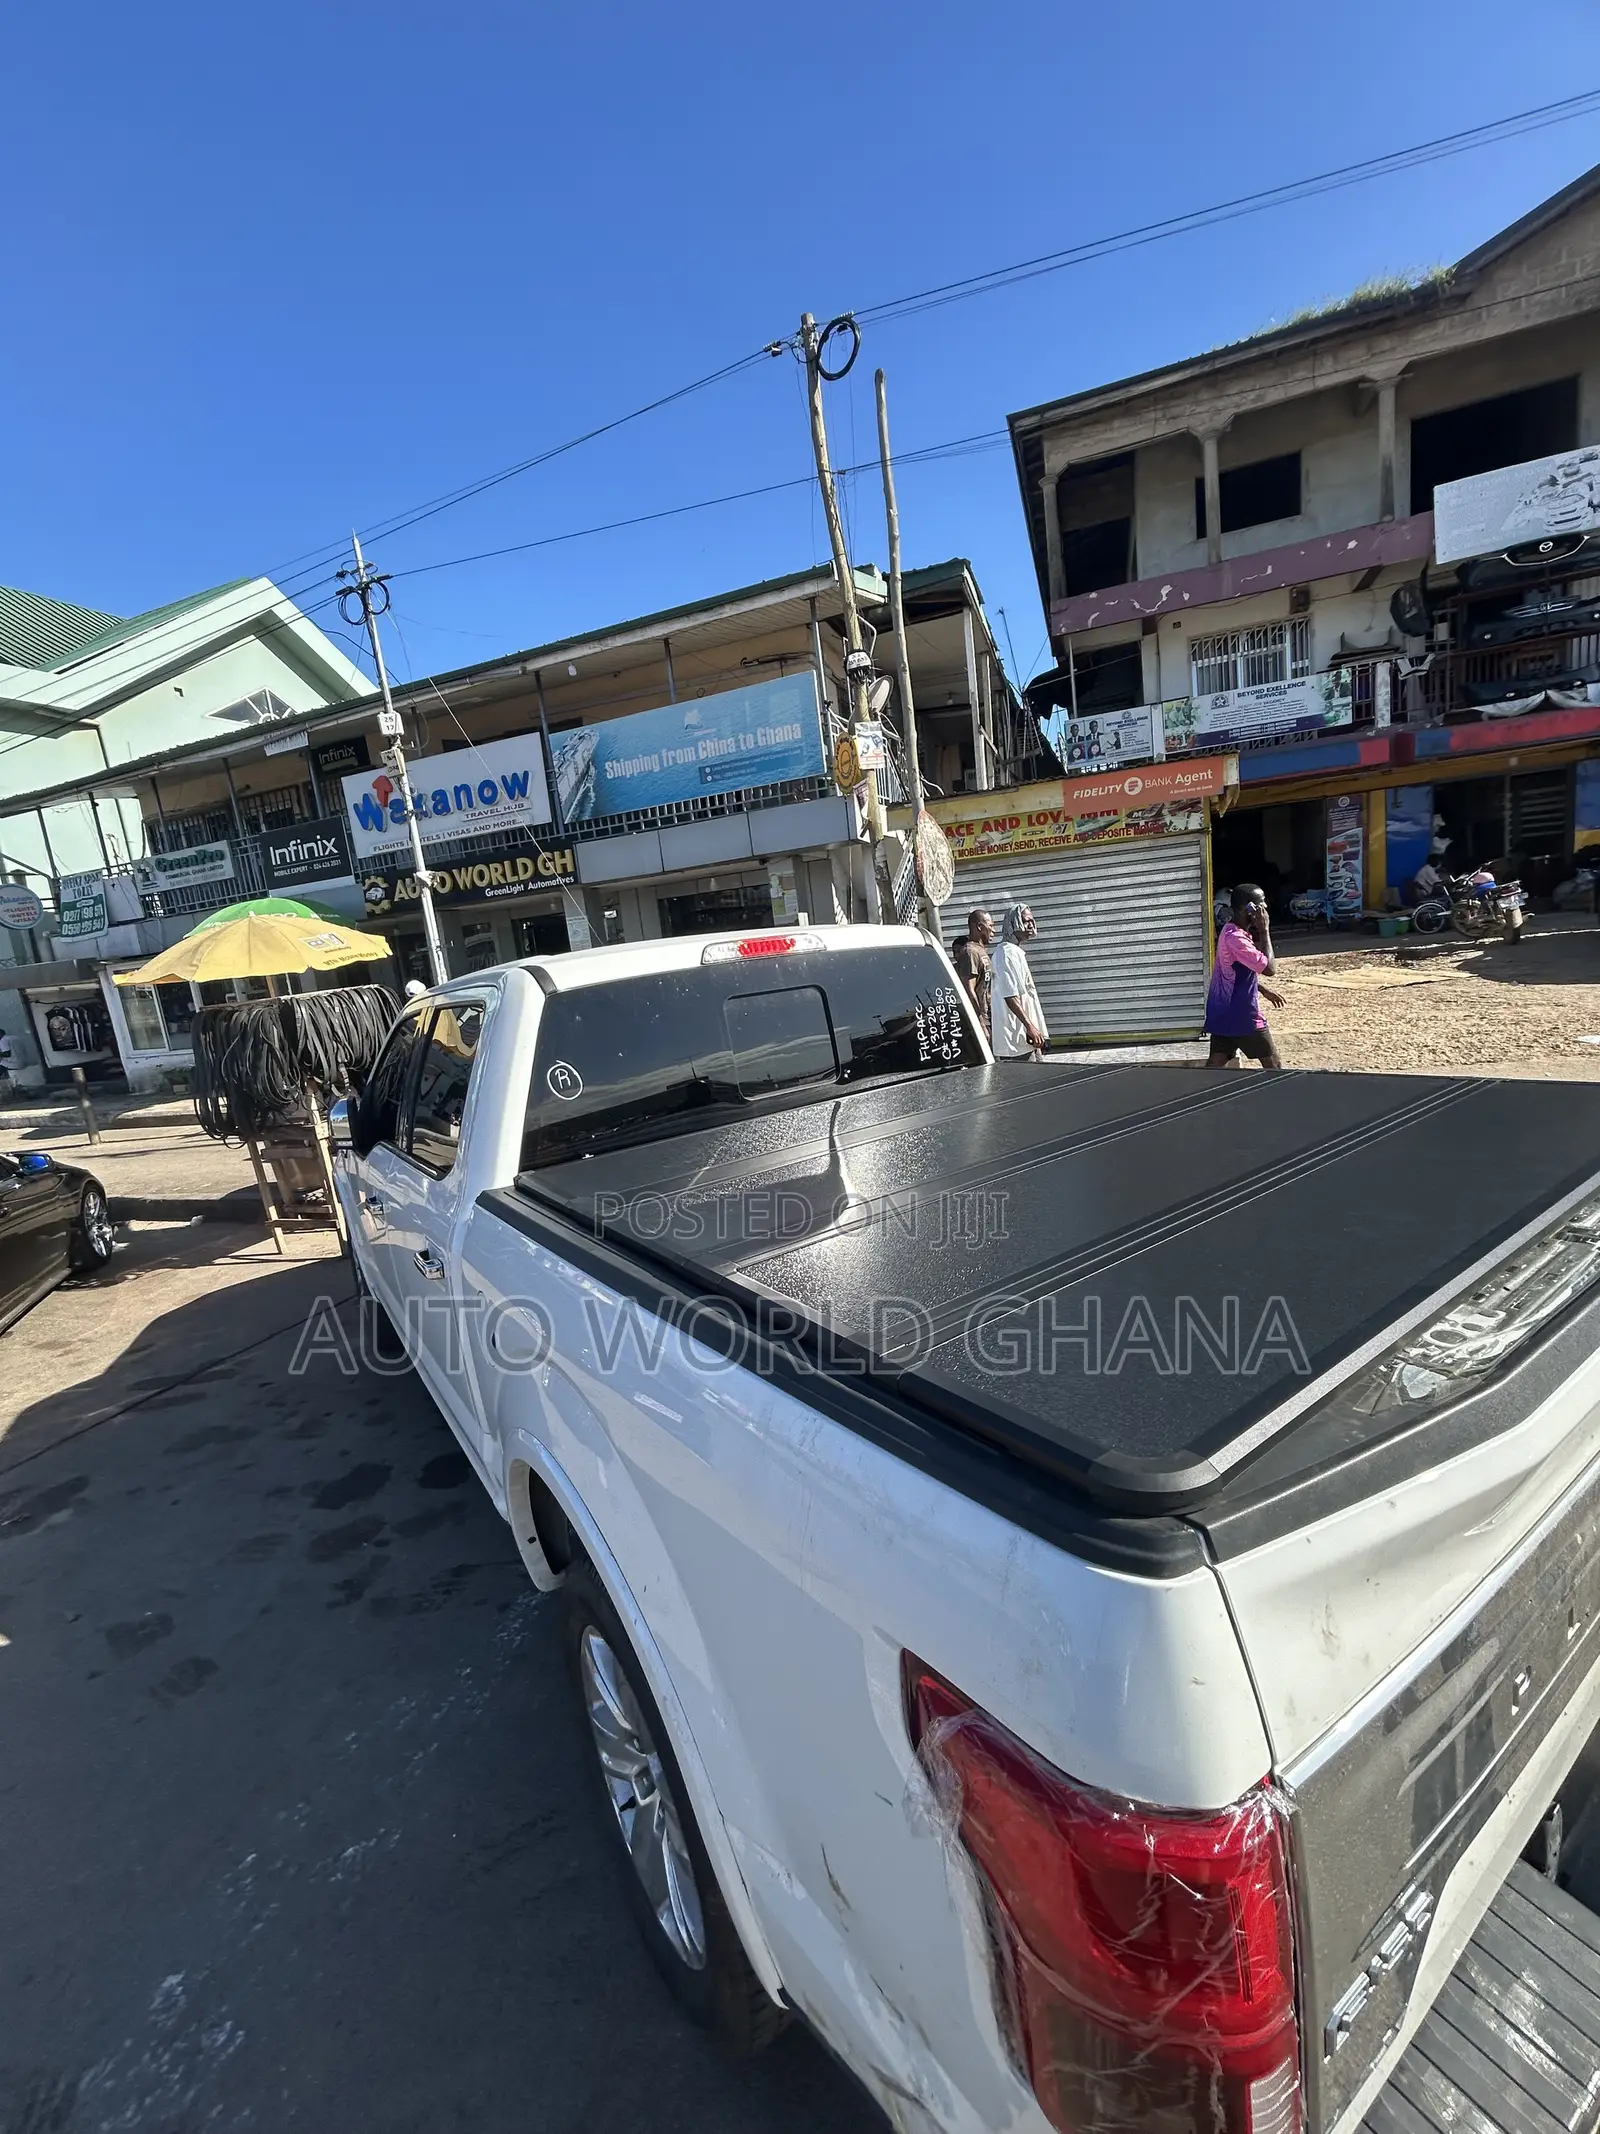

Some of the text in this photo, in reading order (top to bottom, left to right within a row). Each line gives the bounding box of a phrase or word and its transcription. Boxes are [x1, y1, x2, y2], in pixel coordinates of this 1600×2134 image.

[319, 745, 356, 765] Infinix
[605, 753, 660, 780] Shipping
[662, 744, 697, 767] from
[698, 736, 736, 759] China
[738, 732, 754, 749] to
[756, 723, 801, 747] Ghana
[1073, 769, 1213, 799] FIDELITY BANK Agent
[353, 770, 531, 833] Wakanow
[465, 802, 525, 819] TRAVEL HUB
[373, 841, 404, 852] FLIGHTS
[420, 834, 441, 844] TELS
[447, 828, 471, 838] VISAS
[473, 824, 491, 833] AND
[944, 823, 975, 839] ACE
[981, 816, 1020, 834] AND
[270, 835, 339, 866] Infinix
[958, 847, 985, 857] MOBILE
[1039, 835, 1072, 847] RECEIVE
[394, 848, 575, 901] AUO WORLD GH
[485, 883, 525, 898] GreenLight
[555, 1068, 571, 1089] R
